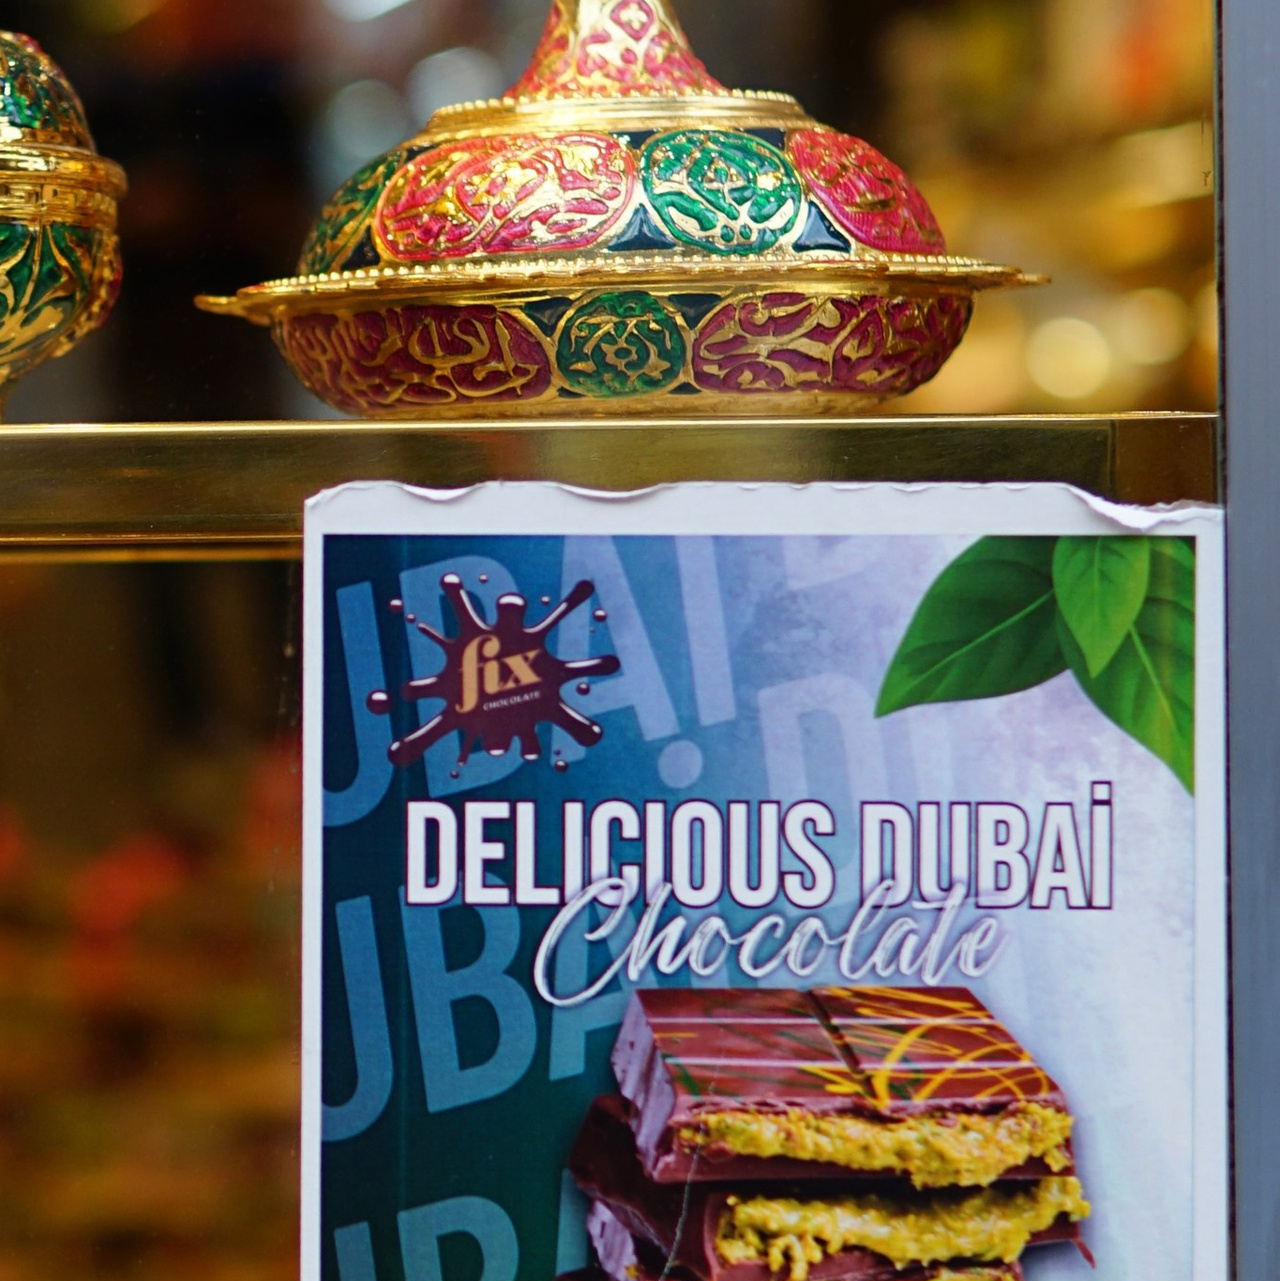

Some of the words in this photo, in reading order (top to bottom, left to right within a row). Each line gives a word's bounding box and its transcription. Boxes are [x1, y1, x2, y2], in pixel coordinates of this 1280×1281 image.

[455, 634, 543, 713] fix
[483, 690, 541, 712] CHOCOLATE
[405, 798, 836, 908] DELICIOUS
[534, 877, 1007, 1008] Chocolate
